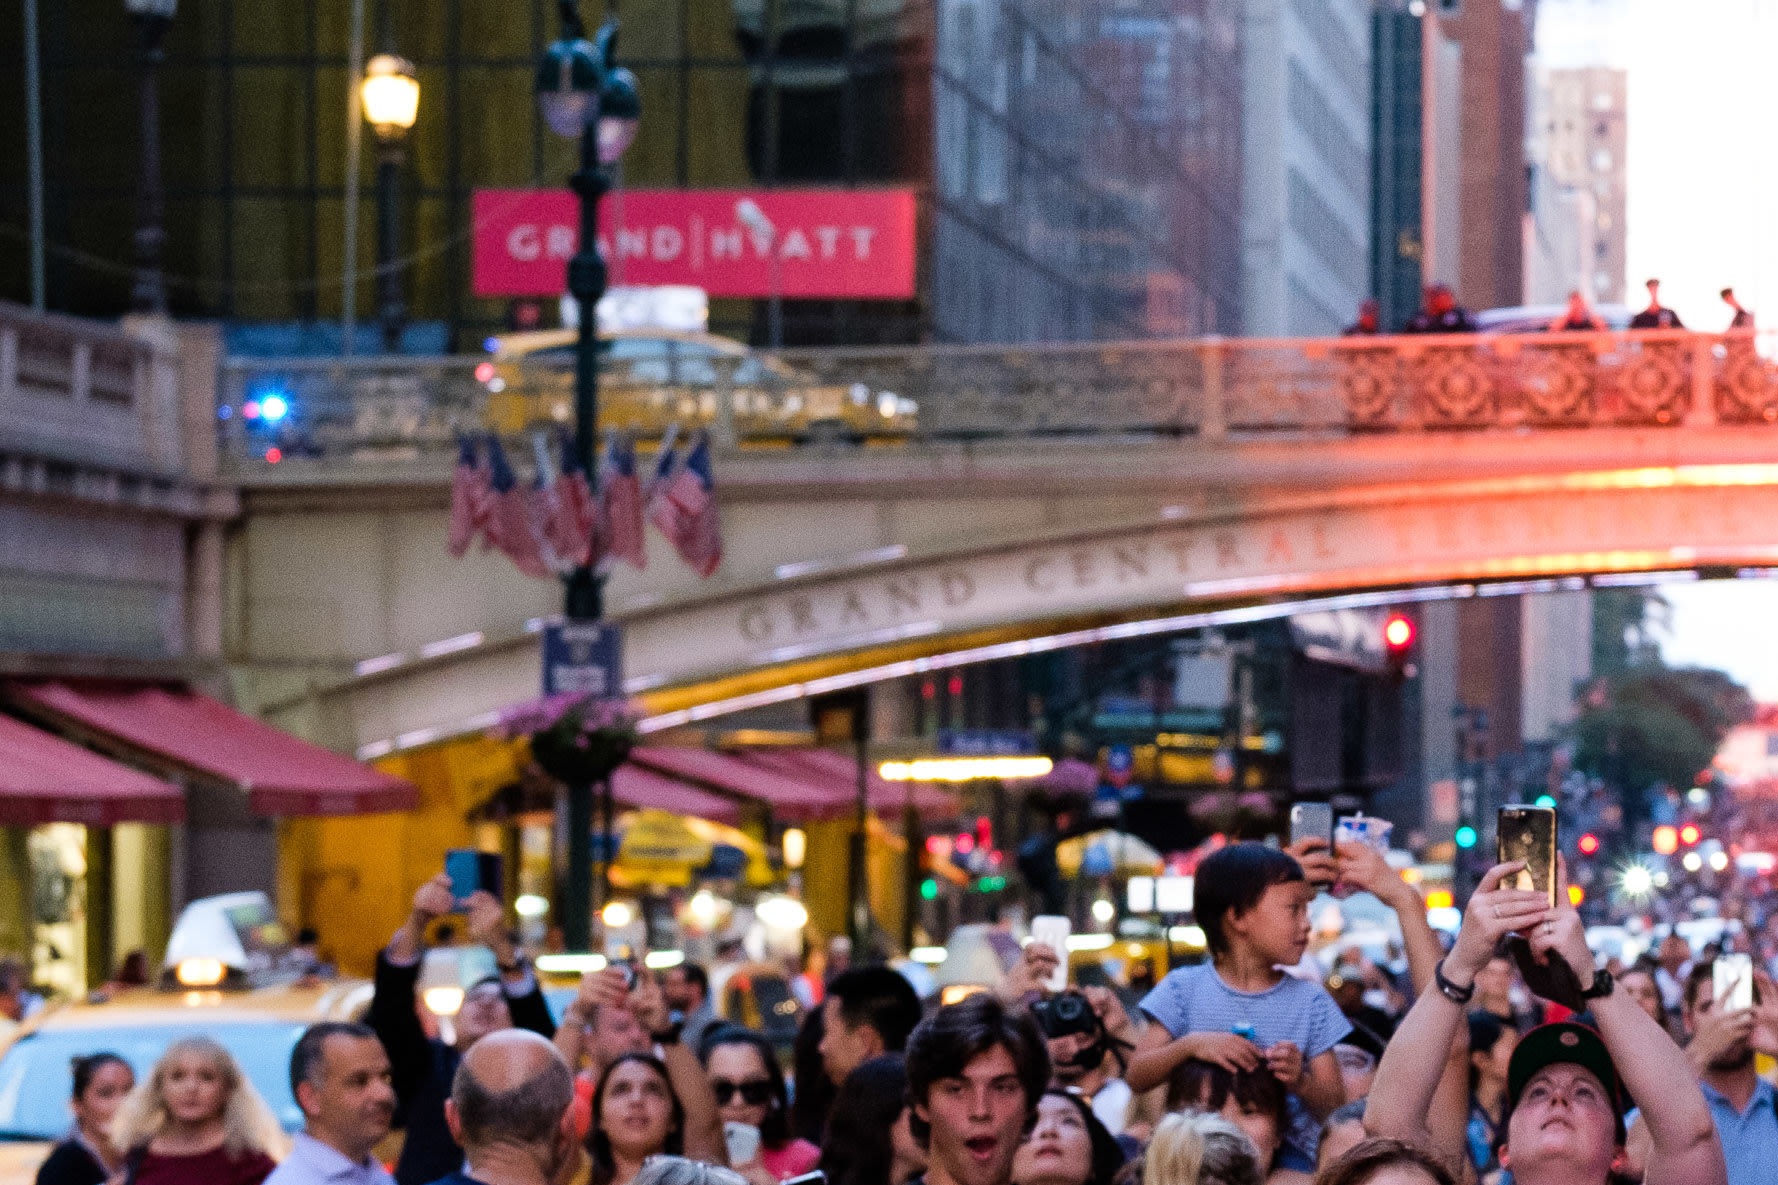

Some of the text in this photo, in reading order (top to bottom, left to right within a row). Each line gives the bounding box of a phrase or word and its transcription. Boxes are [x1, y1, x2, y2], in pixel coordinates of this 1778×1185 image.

[712, 222, 875, 261] HYATT
[739, 571, 978, 643] GRAND
[1023, 525, 1338, 593] CENTRAL
